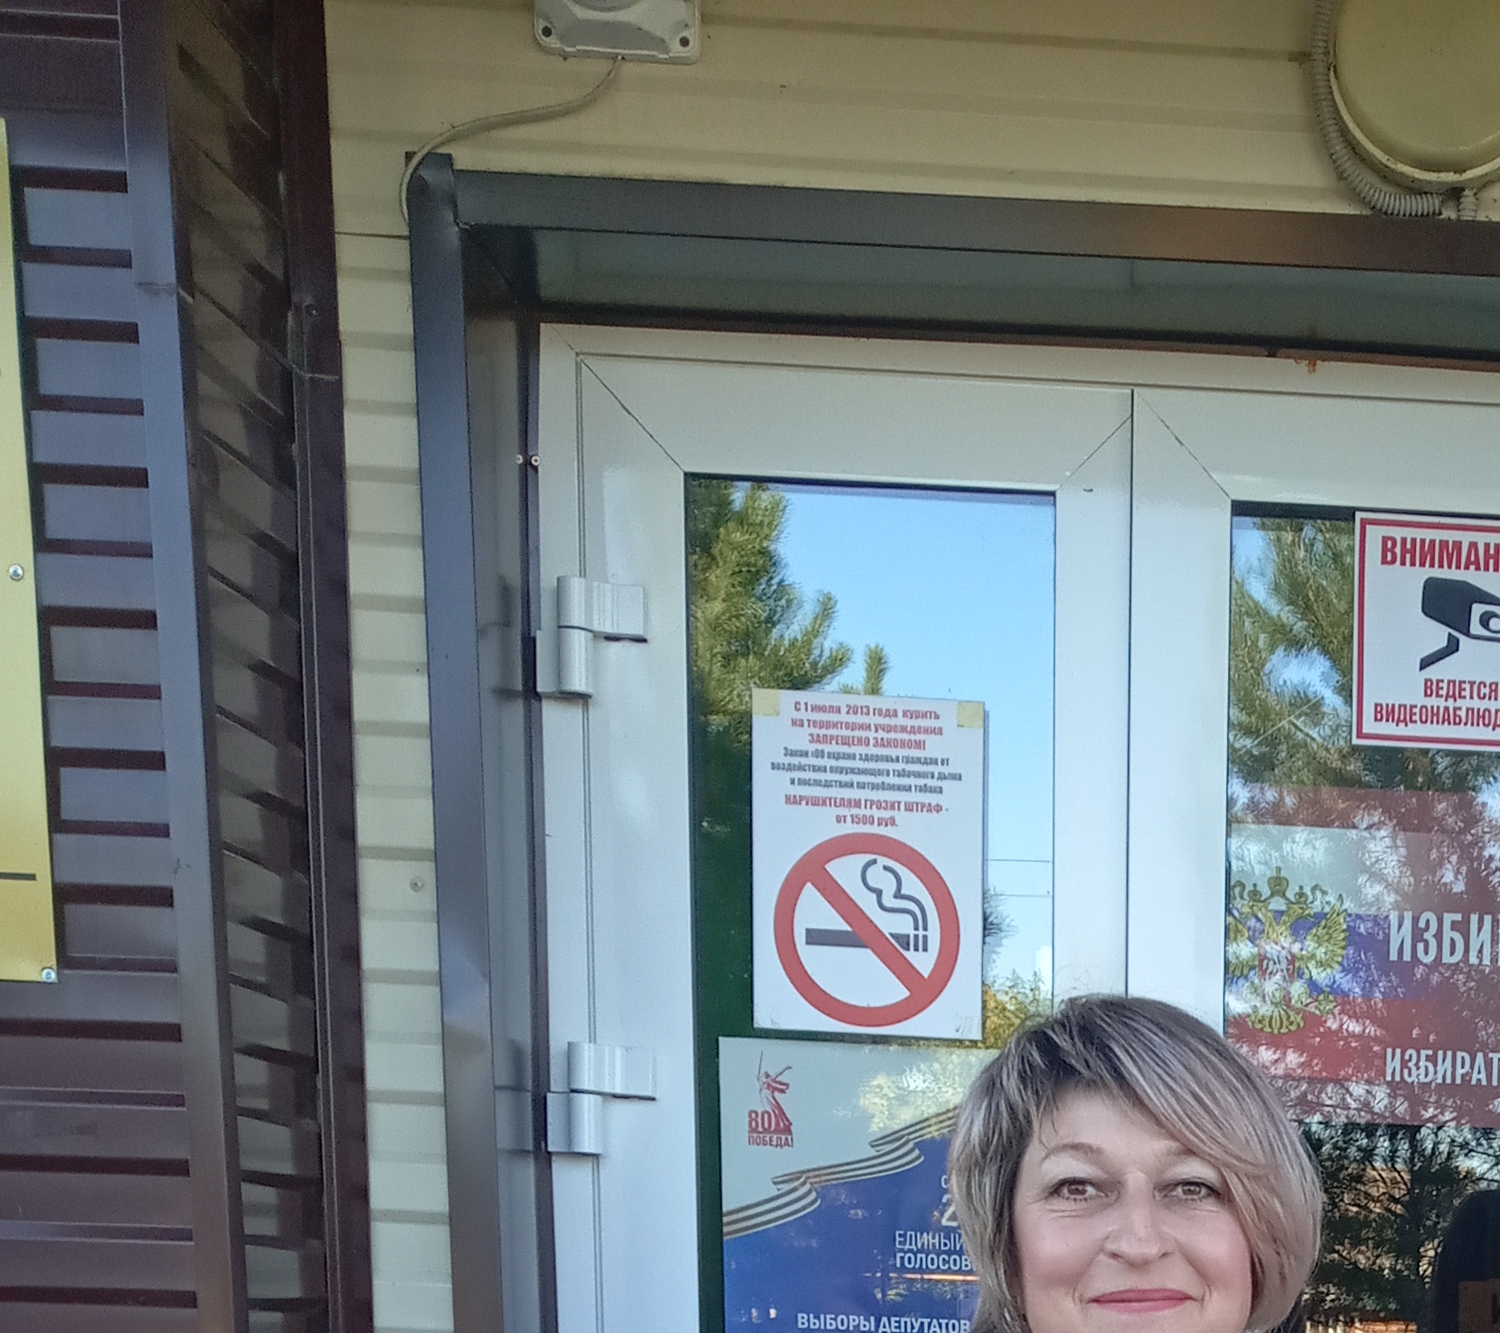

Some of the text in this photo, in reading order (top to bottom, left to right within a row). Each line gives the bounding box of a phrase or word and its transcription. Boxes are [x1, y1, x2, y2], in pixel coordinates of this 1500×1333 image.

[1423, 678, 1499, 702] ВЕДЕТСЯ
[794, 701, 940, 721] С 1 июля 2013 года курить
[791, 718, 943, 736] на территории учреждения
[809, 733, 926, 750] ЗАПРЕЩЕНО ЗАКОНОМ!
[859, 753, 899, 764] здоровья
[902, 755, 938, 767] граждан
[771, 762, 827, 773] воздействия
[829, 766, 890, 777] окружающего
[893, 769, 935, 780] табачного
[856, 781, 912, 792] потребления
[914, 784, 943, 794] табака
[785, 794, 862, 810] НАРУШИТЕЛЯМ
[864, 800, 901, 811] ГРОЗИТ
[904, 802, 942, 814] ШТРАФ
[836, 814, 897, 827] от 1500 руб.
[748, 1110, 772, 1133] 80
[748, 1134, 794, 1148] ПОБЕДА!
[797, 1313, 875, 1331] ВЫБОРЫ
